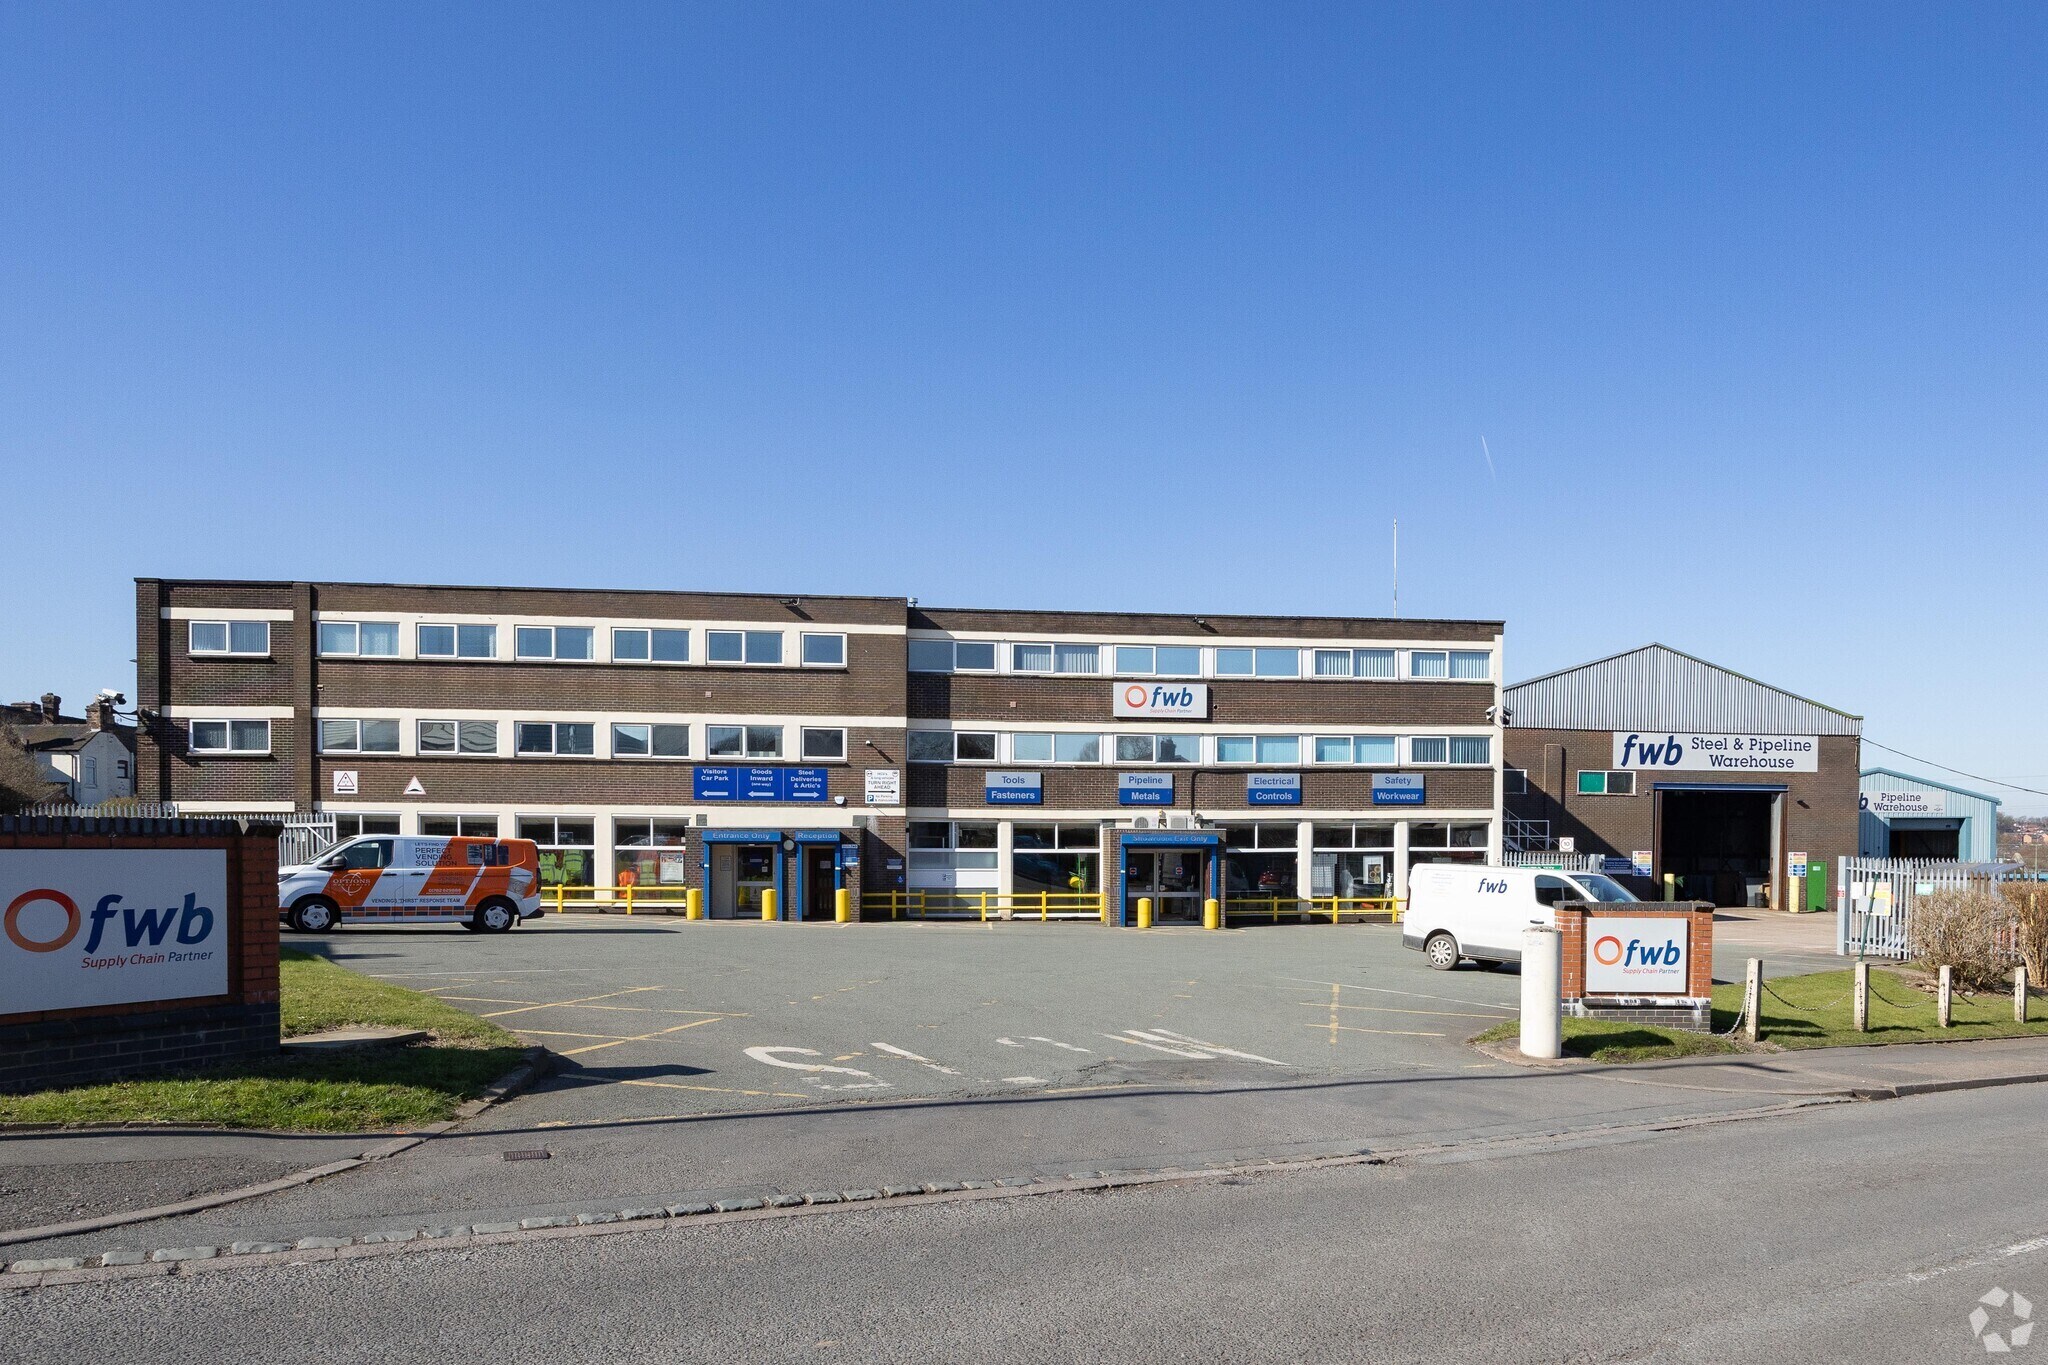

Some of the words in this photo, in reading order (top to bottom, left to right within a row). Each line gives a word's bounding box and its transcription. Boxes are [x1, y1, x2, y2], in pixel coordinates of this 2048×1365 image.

[1151, 686, 1193, 707] fwb
[1691, 737, 1728, 750] Steel
[1734, 738, 1744, 751] &
[1749, 738, 1812, 754] Pipeline
[1621, 734, 1683, 767] fwb
[1709, 755, 1795, 768] Warehouse
[1002, 776, 1025, 784] Tools
[1128, 776, 1163, 785] Pipeline
[1253, 777, 1294, 785] Electrical
[1384, 776, 1412, 786] Safety
[991, 791, 1035, 799] Fasteners
[1131, 791, 1160, 800] Metals
[1255, 792, 1292, 800] Controls
[1377, 792, 1419, 800] Workwear
[1881, 792, 1922, 803] Pipeline
[1873, 803, 1928, 811] Warehouse
[798, 832, 838, 840] Reception
[1478, 878, 1508, 893] fwb
[84, 892, 214, 954] fwb
[1624, 939, 1680, 967] fwb
[81, 955, 128, 970] Supply
[130, 953, 165, 965] Chain
[168, 950, 213, 962] Partner
[1622, 967, 1642, 975] Supply
